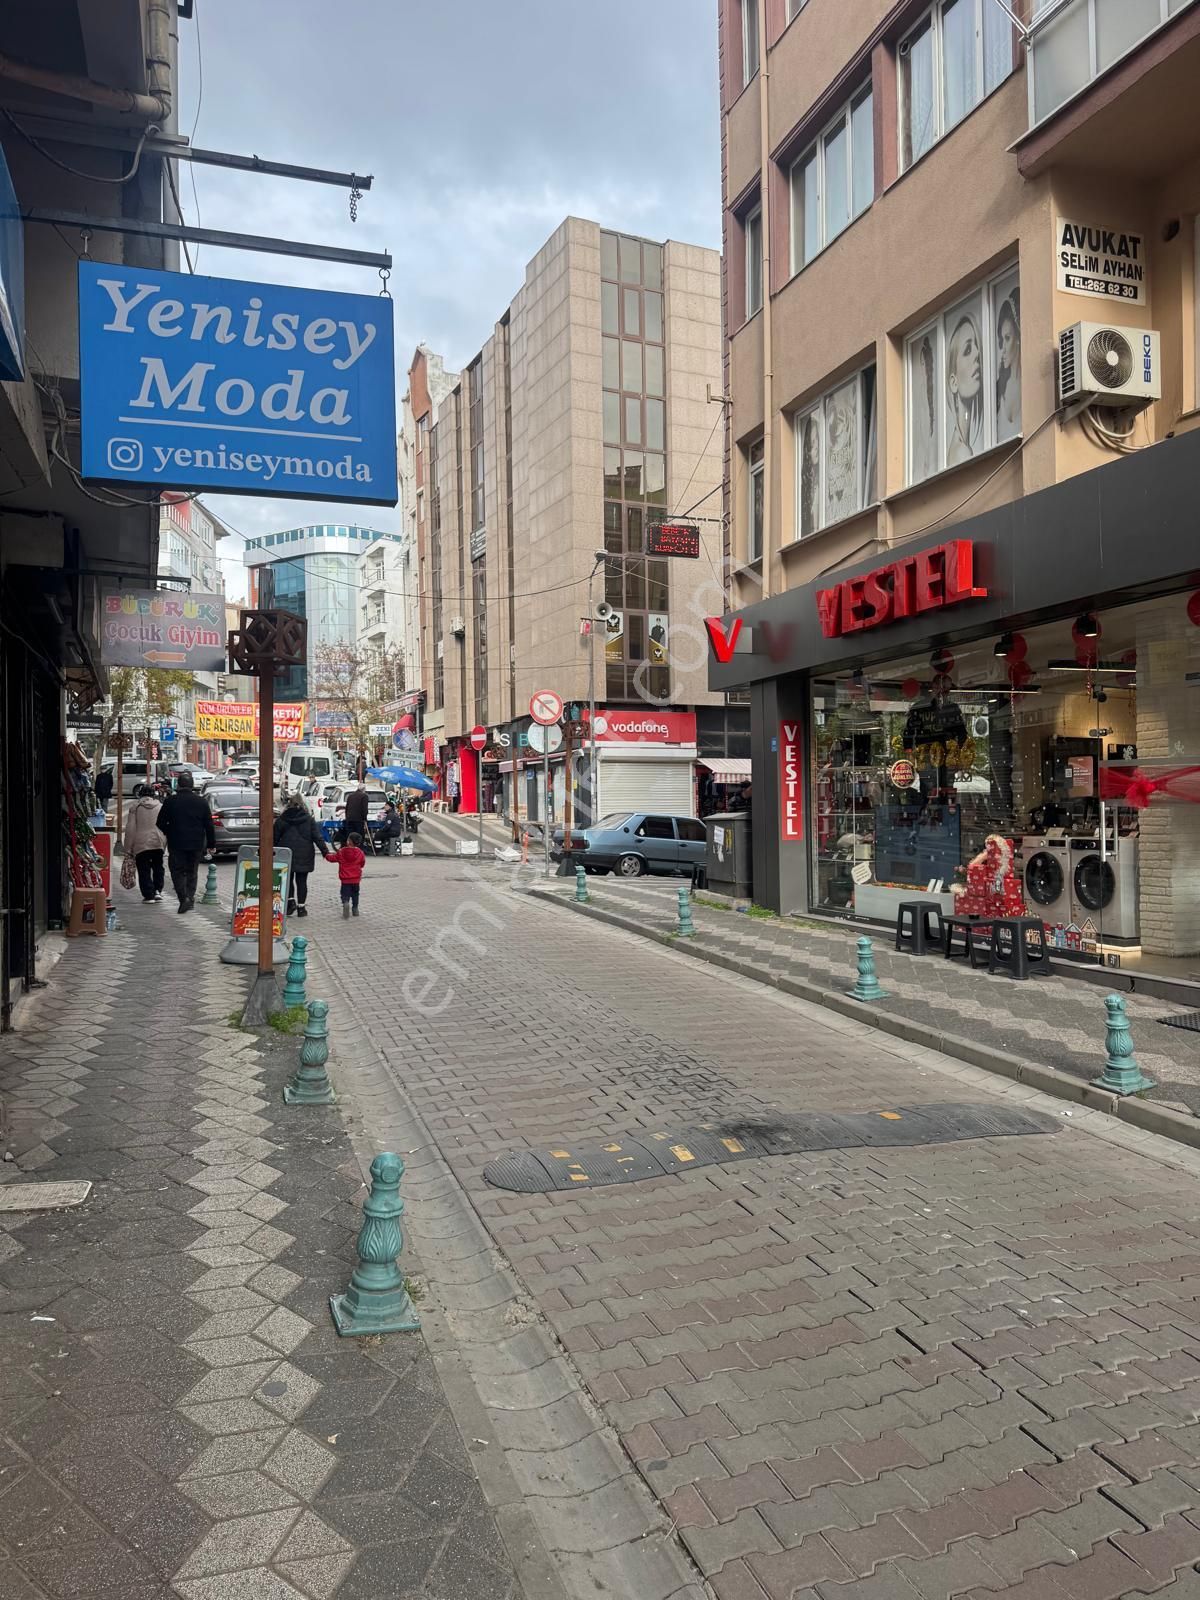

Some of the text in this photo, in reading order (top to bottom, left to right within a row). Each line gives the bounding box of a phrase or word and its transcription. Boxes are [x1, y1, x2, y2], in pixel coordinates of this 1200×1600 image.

[1061, 223, 1140, 259] AVUKAT
[1069, 276, 1134, 298] TEL:262 62 30
[1103, 258, 1142, 281] AYHAN
[97, 278, 376, 370] Yenisey
[1143, 334, 1151, 383] BEKO
[129, 356, 352, 426] Moda
[152, 444, 373, 483] yeniseymoda
[816, 538, 987, 640] VESTEL
[105, 620, 221, 650] Çocuk Giyim
[162, 729, 172, 738] P
[199, 717, 252, 733] NE ALIRSAN
[611, 720, 668, 738] vodafone
[783, 725, 798, 836] VESTEL
